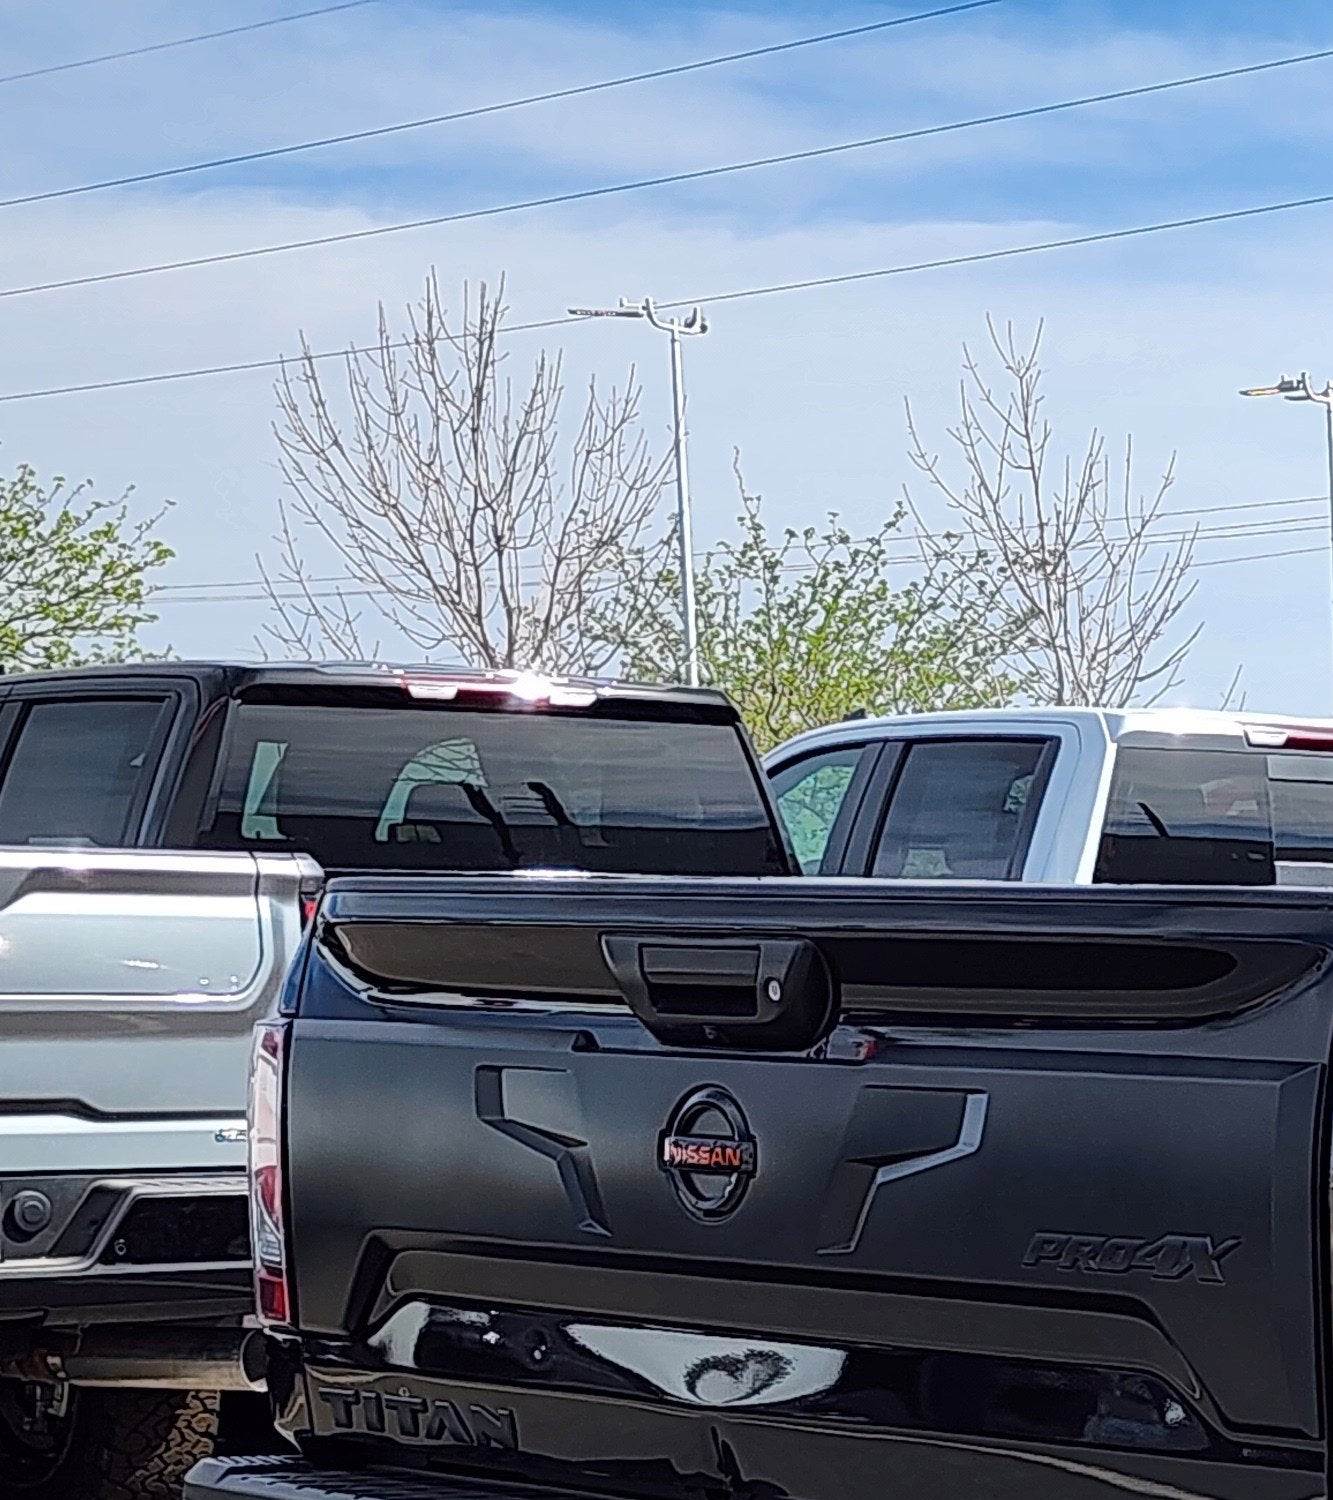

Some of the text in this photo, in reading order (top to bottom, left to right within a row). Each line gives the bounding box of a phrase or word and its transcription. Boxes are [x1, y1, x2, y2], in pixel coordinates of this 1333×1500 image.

[664, 1138, 741, 1167] NISSAN
[1021, 1232, 1243, 1285] PRO4X
[318, 1386, 519, 1450] TITAN
